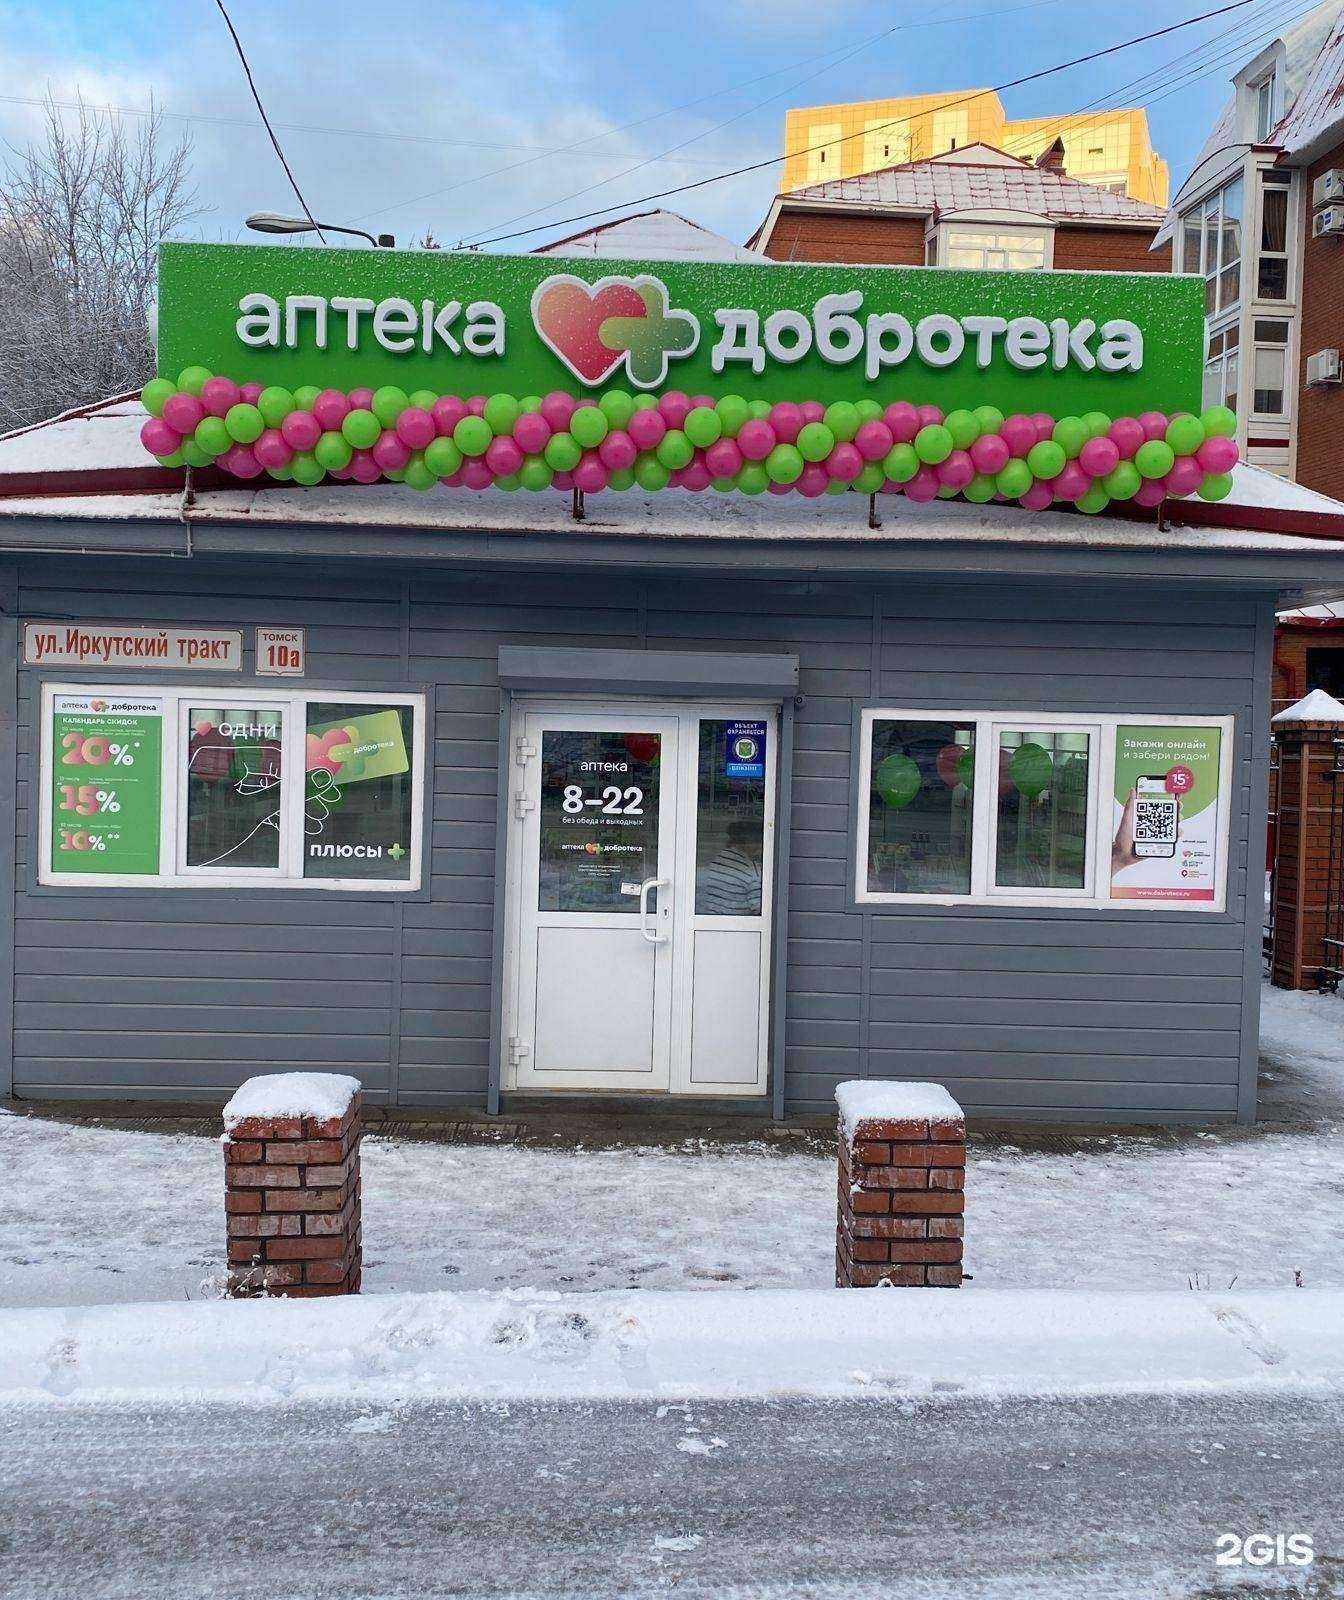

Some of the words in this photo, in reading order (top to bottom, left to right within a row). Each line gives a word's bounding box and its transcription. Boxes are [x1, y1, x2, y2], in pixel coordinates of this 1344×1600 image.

[235, 293, 505, 356] аптека
[711, 290, 1144, 381] добротека
[262, 633, 298, 642] ТОМСК
[177, 637, 231, 664] тракт
[267, 645, 300, 667] 10а
[111, 703, 157, 711] добротека
[62, 717, 105, 725] КАЛЕНДАРЬ
[106, 718, 138, 726] СКИДОК
[1123, 739, 1164, 748] Закажи
[1166, 738, 1206, 749] онлайн
[1132, 751, 1171, 760] забери
[1173, 752, 1210, 761] рядом!
[580, 761, 628, 772] аптека
[59, 785, 121, 816] 15%
[562, 816, 575, 824] без
[576, 817, 599, 825] обеда
[603, 843, 643, 852] добротека
